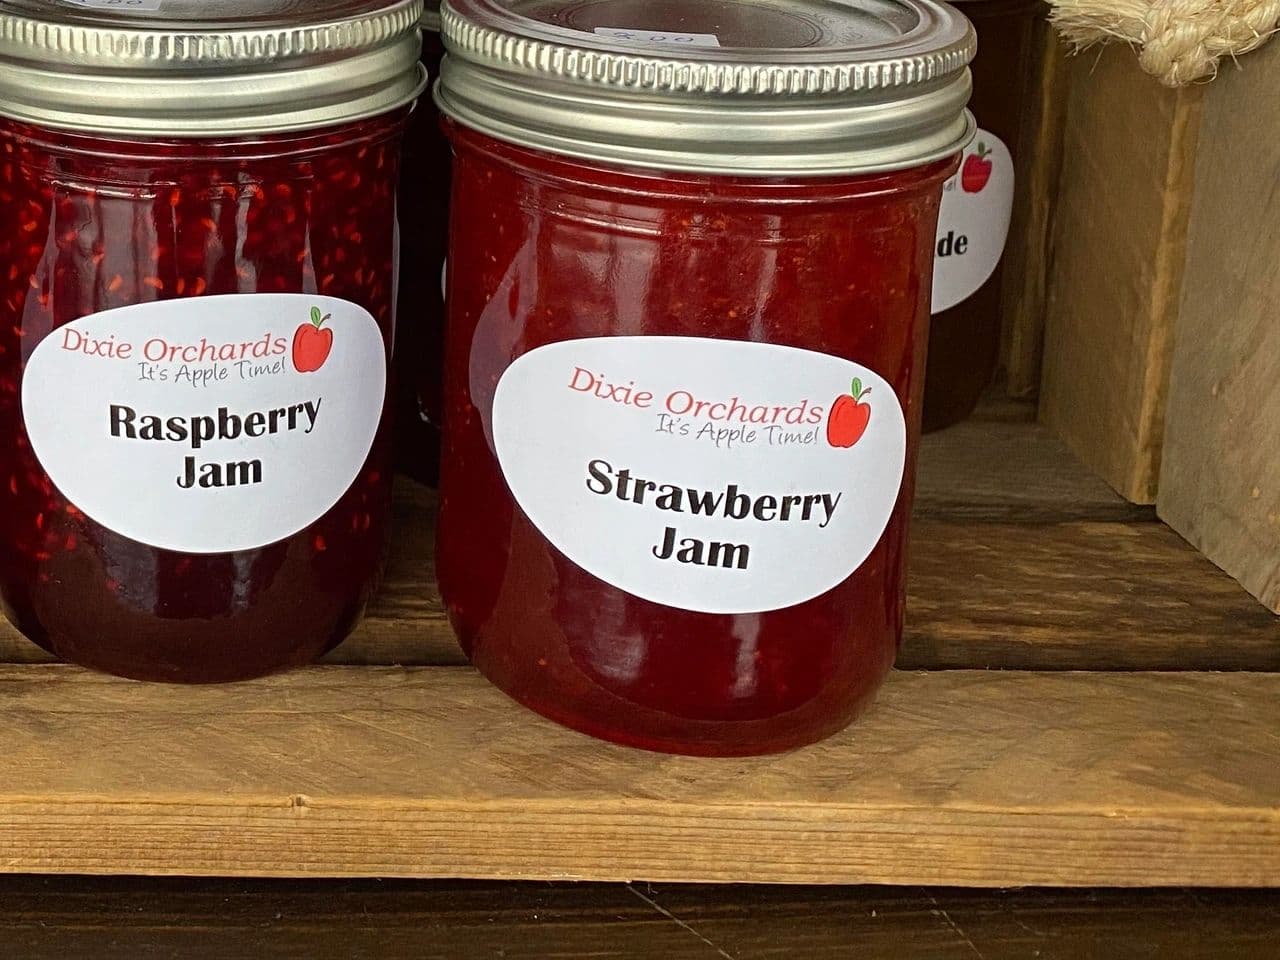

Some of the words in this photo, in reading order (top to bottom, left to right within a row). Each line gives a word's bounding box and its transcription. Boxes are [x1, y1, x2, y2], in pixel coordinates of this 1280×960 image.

[61, 327, 132, 360] Dixie
[144, 332, 288, 363] Orchards
[138, 361, 168, 382] It's
[174, 362, 229, 388] Apple
[234, 356, 287, 379] Time!
[567, 366, 653, 409] Dixie
[665, 389, 824, 425] Orchards
[109, 397, 322, 449] Raspberry
[655, 412, 689, 436] It's
[695, 421, 757, 449] Apple
[763, 424, 820, 446] Time!
[176, 455, 263, 490] Jam
[585, 458, 843, 529] Strawberry
[651, 526, 751, 570] Jam
